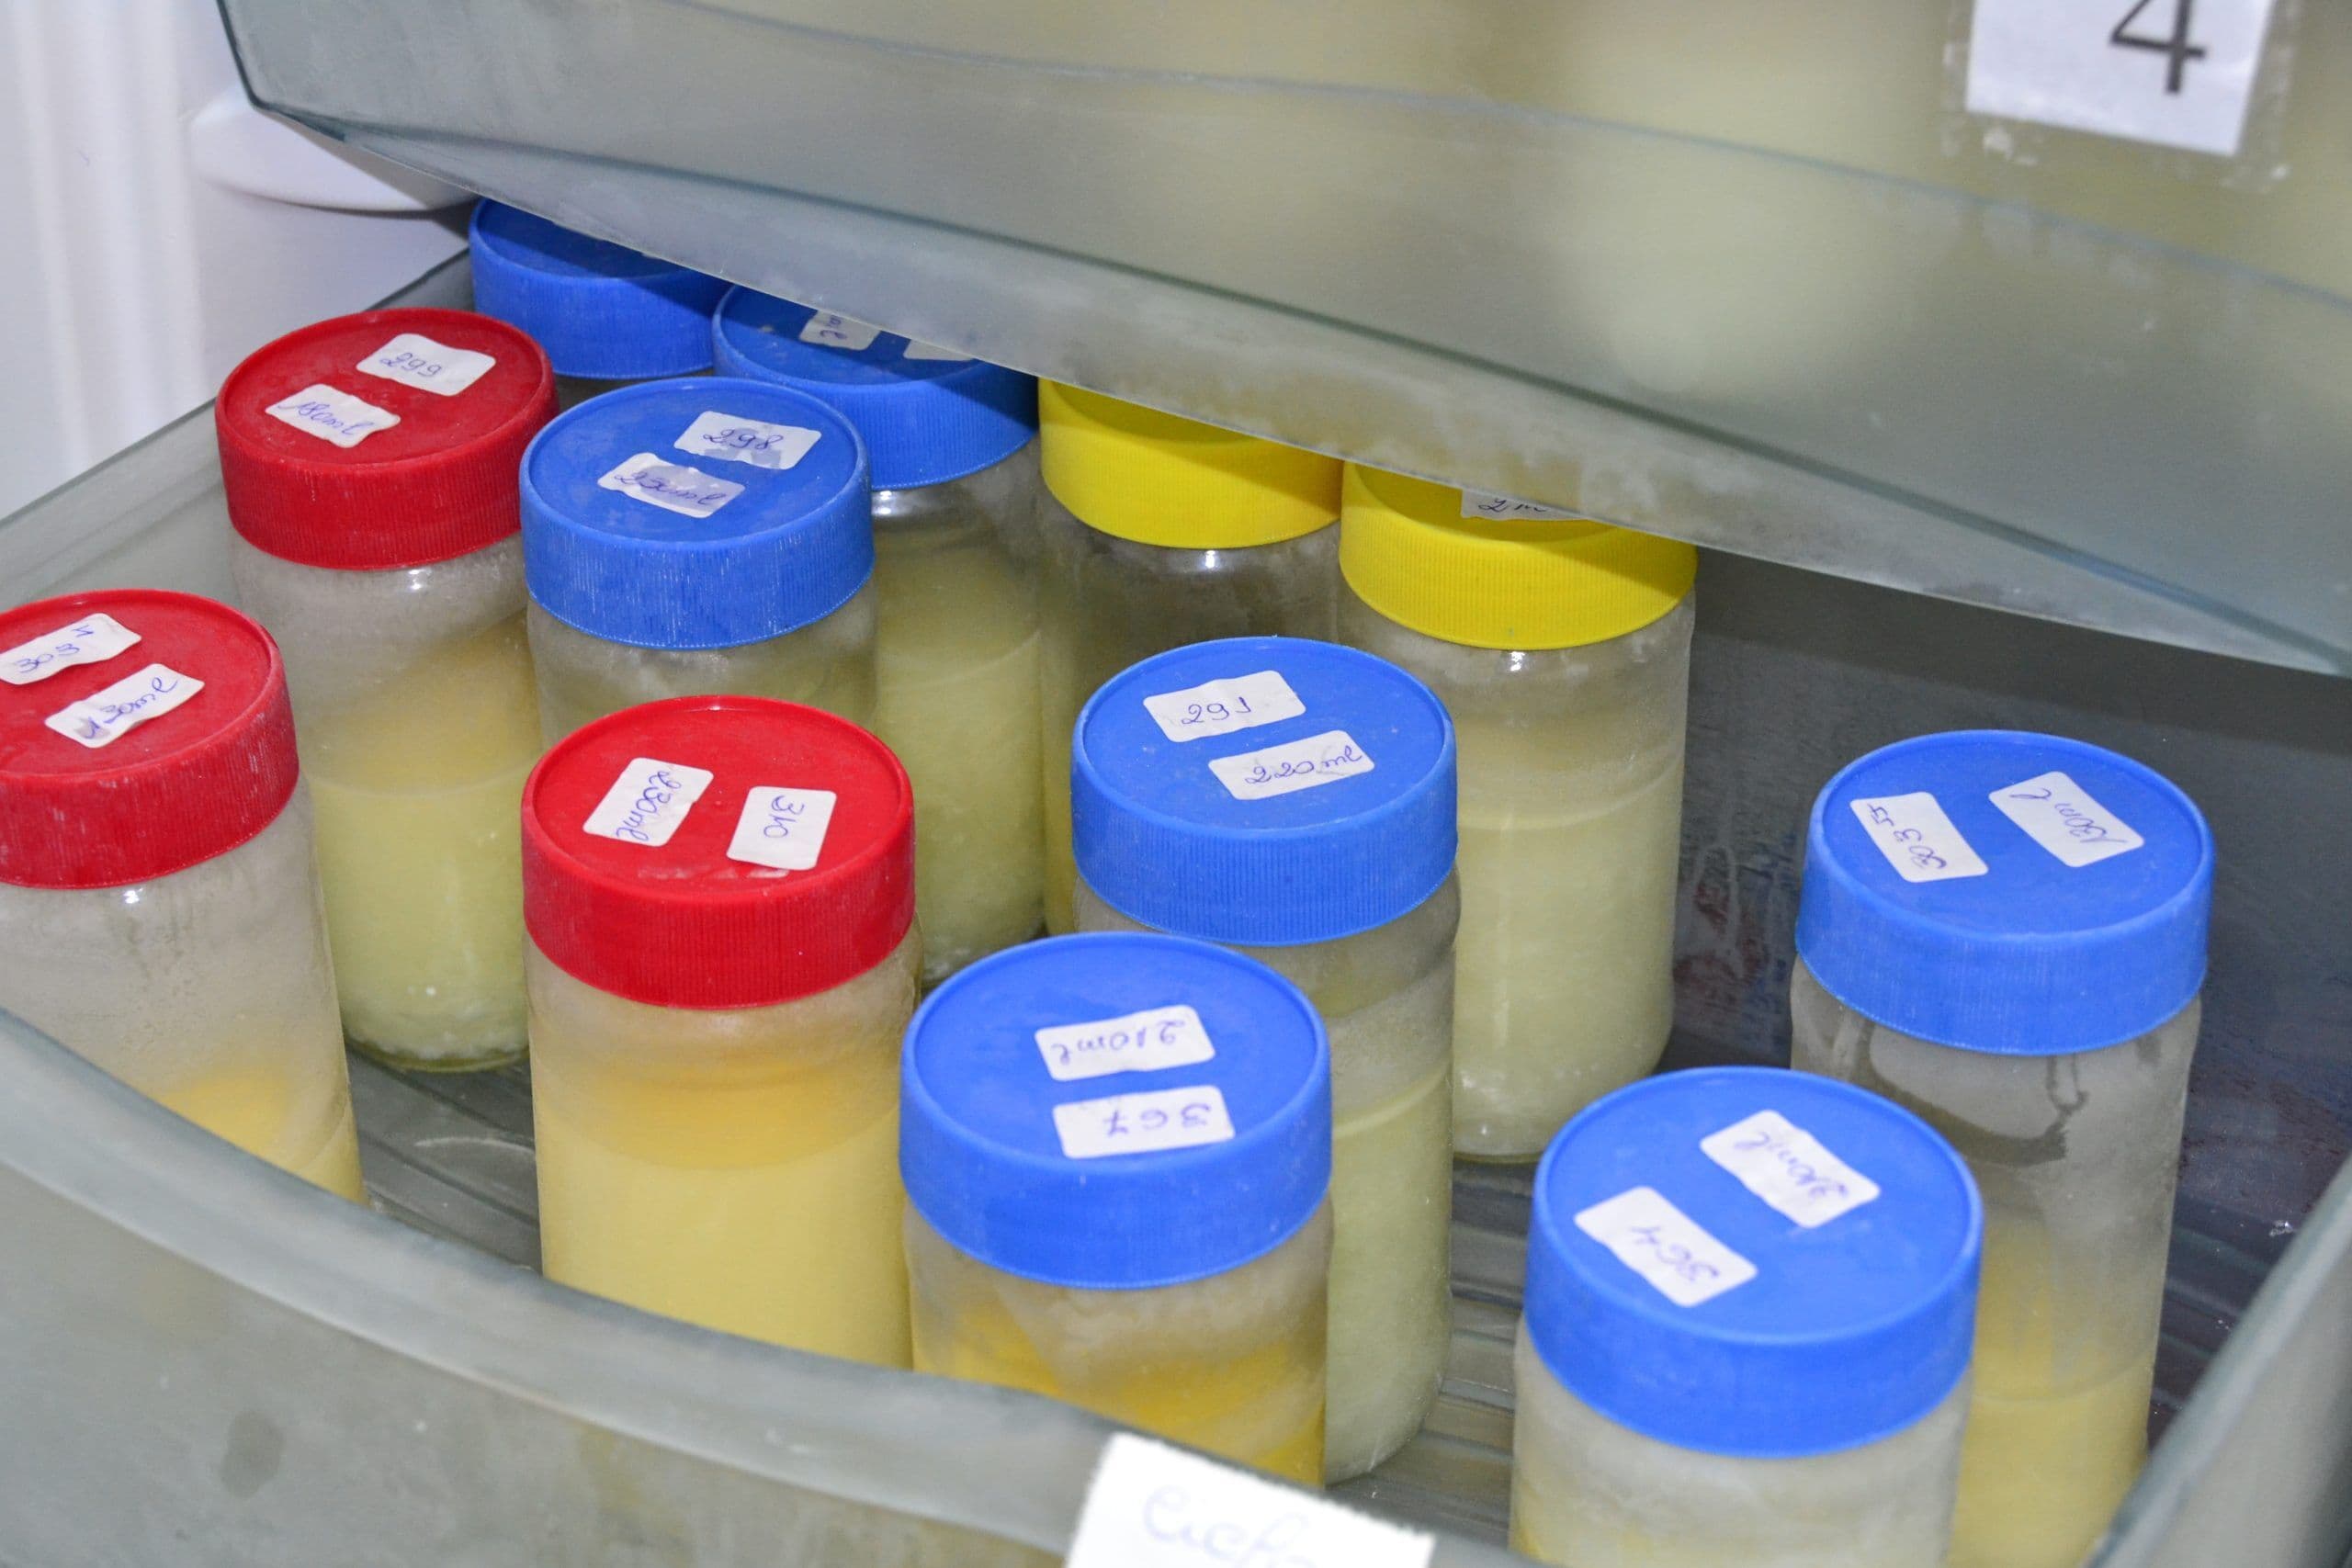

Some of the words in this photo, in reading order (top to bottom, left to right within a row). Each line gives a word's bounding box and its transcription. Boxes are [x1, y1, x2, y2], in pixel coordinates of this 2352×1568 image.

[2109, 0, 2209, 95] 4
[379, 352, 443, 378] 299
[702, 428, 785, 450] 298
[616, 770, 682, 842] 230ml
